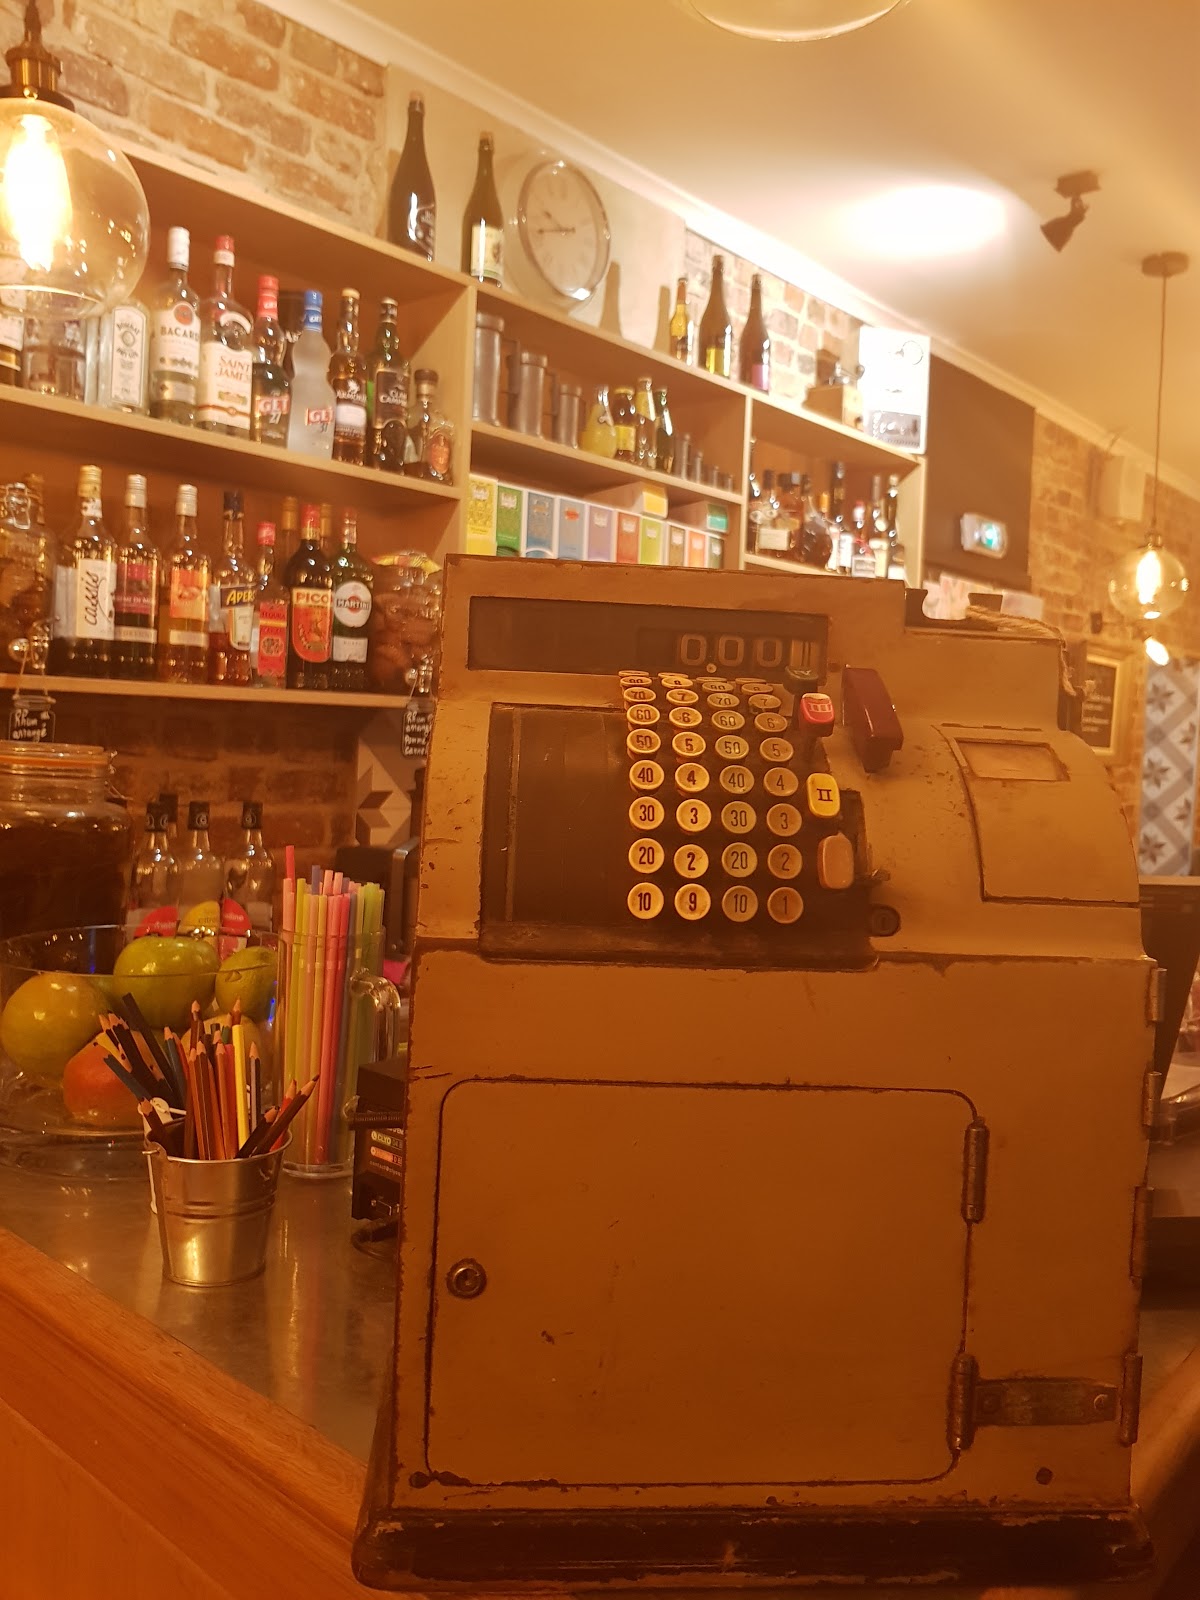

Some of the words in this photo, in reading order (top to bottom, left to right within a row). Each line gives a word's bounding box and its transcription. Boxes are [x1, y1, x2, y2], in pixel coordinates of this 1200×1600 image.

[336, 597, 369, 610] MARTINI
[677, 692, 685, 702] 7
[715, 696, 731, 706] 70
[760, 697, 769, 707] 7
[637, 709, 651, 720] 60
[720, 714, 737, 727] 60
[766, 716, 776, 729] 6
[636, 734, 652, 749] 50
[685, 738, 694, 752] 5
[724, 740, 741, 755] 50
[772, 743, 781, 757] 5
[637, 766, 654, 783] 40
[686, 769, 697, 786] 4
[728, 772, 745, 789] 40
[775, 774, 785, 791] 4
[639, 804, 655, 822] 30
[690, 806, 699, 825] 3
[730, 809, 747, 828] 30
[780, 811, 789, 830] 3
[639, 846, 655, 865] 20
[686, 851, 696, 871] 2
[731, 850, 748, 870] 20
[780, 852, 790, 872] 2
[637, 892, 652, 912] 10
[688, 891, 697, 912] 9
[733, 893, 748, 914] 10
